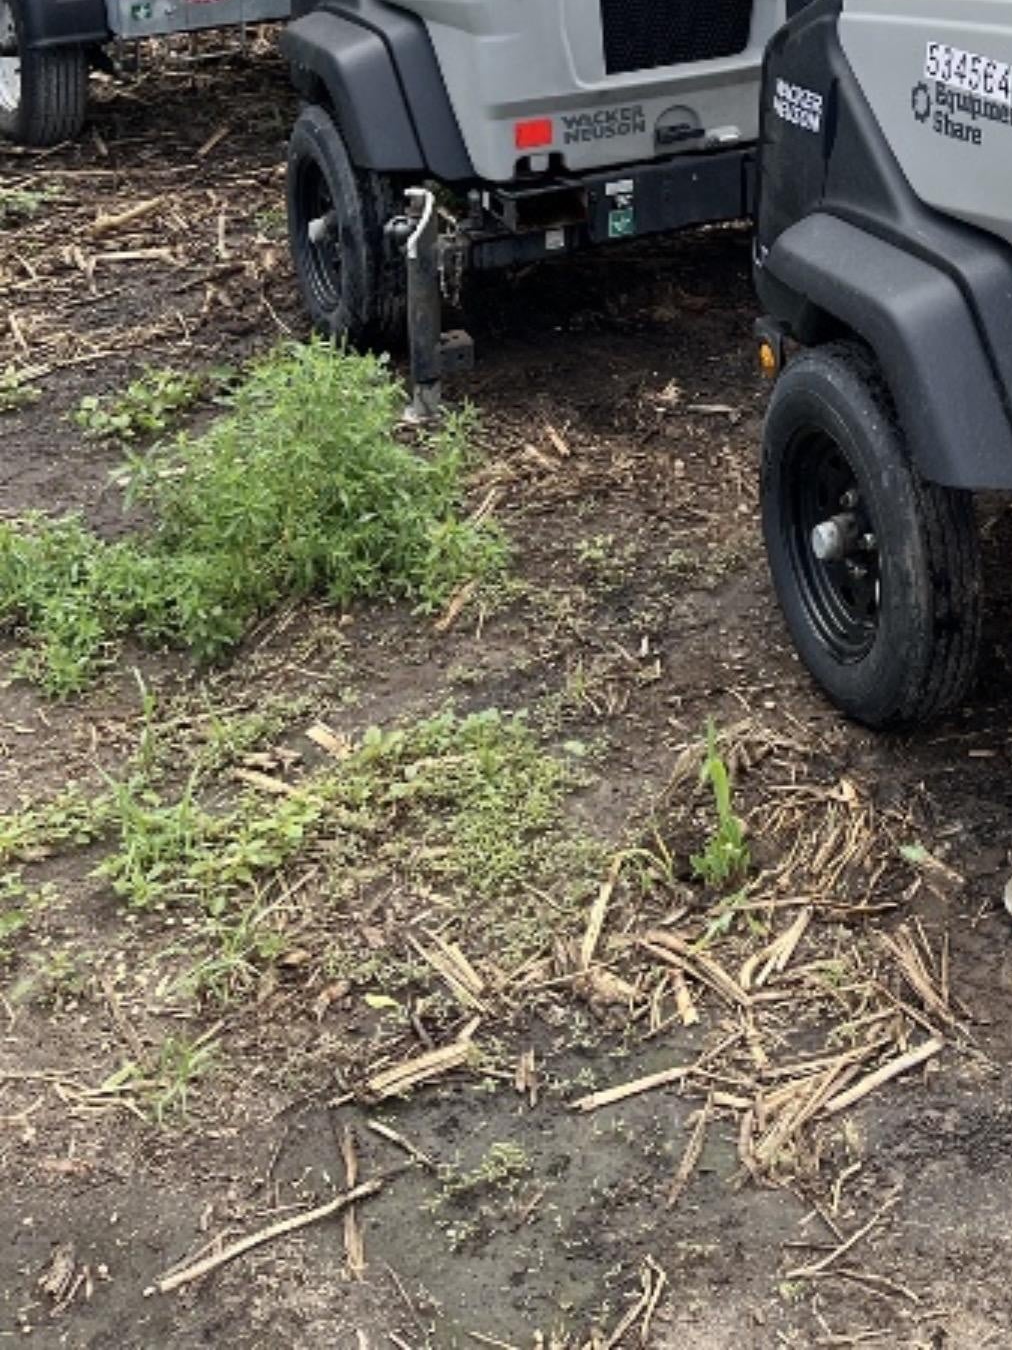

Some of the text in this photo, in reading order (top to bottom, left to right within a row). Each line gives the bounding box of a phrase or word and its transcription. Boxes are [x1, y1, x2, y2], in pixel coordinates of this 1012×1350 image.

[926, 44, 1010, 99] 534564
[560, 105, 645, 129] WACKER
[933, 111, 982, 145] Share
